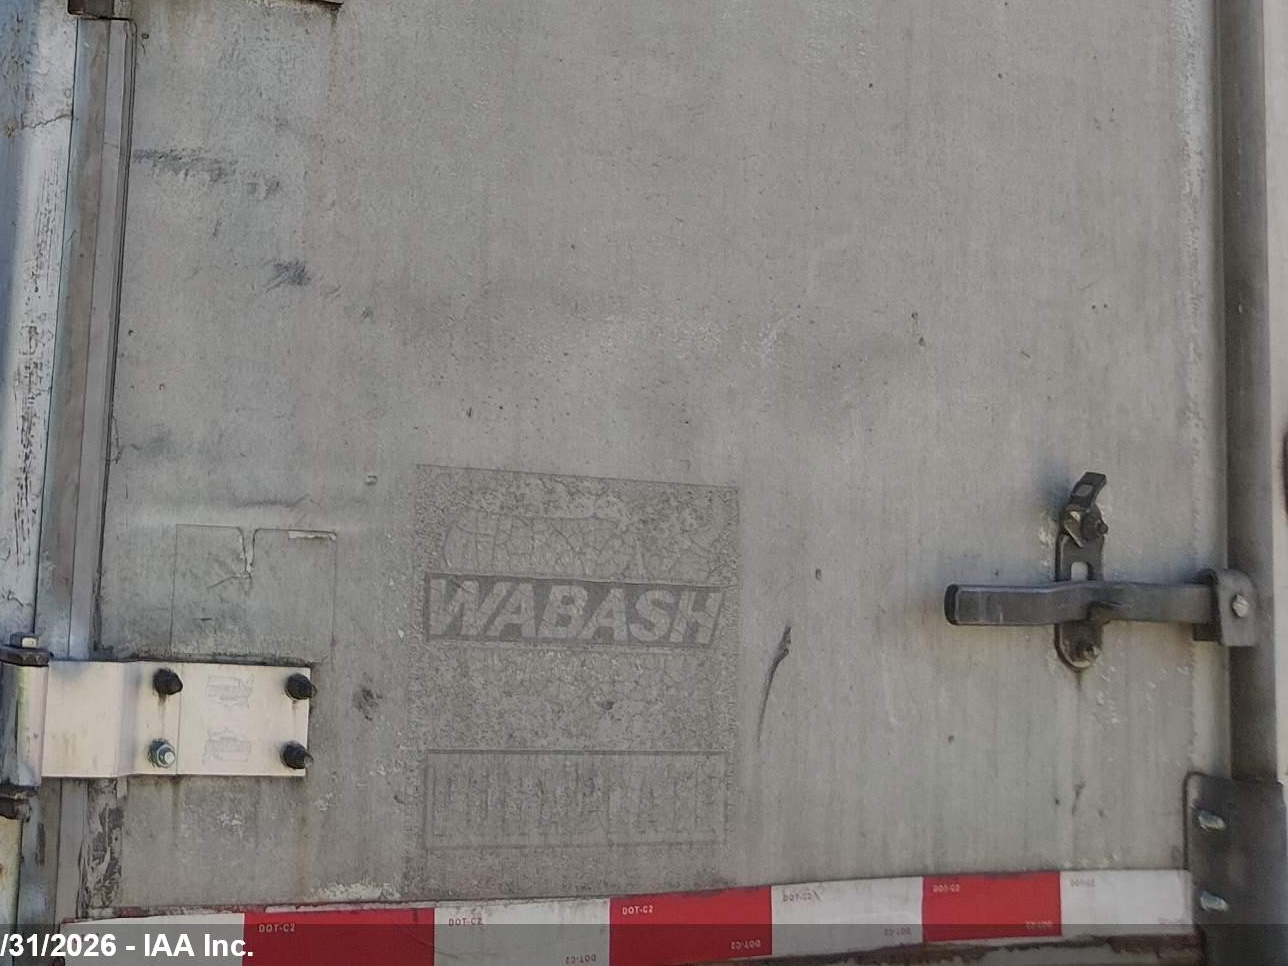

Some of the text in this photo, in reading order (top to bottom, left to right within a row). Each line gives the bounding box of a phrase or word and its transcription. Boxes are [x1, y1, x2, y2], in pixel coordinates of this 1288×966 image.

[429, 578, 724, 645] WABASH
[622, 905, 653, 915] DOT-C2
[448, 917, 483, 927] DOT-C2
[258, 923, 295, 933] DOT-C2
